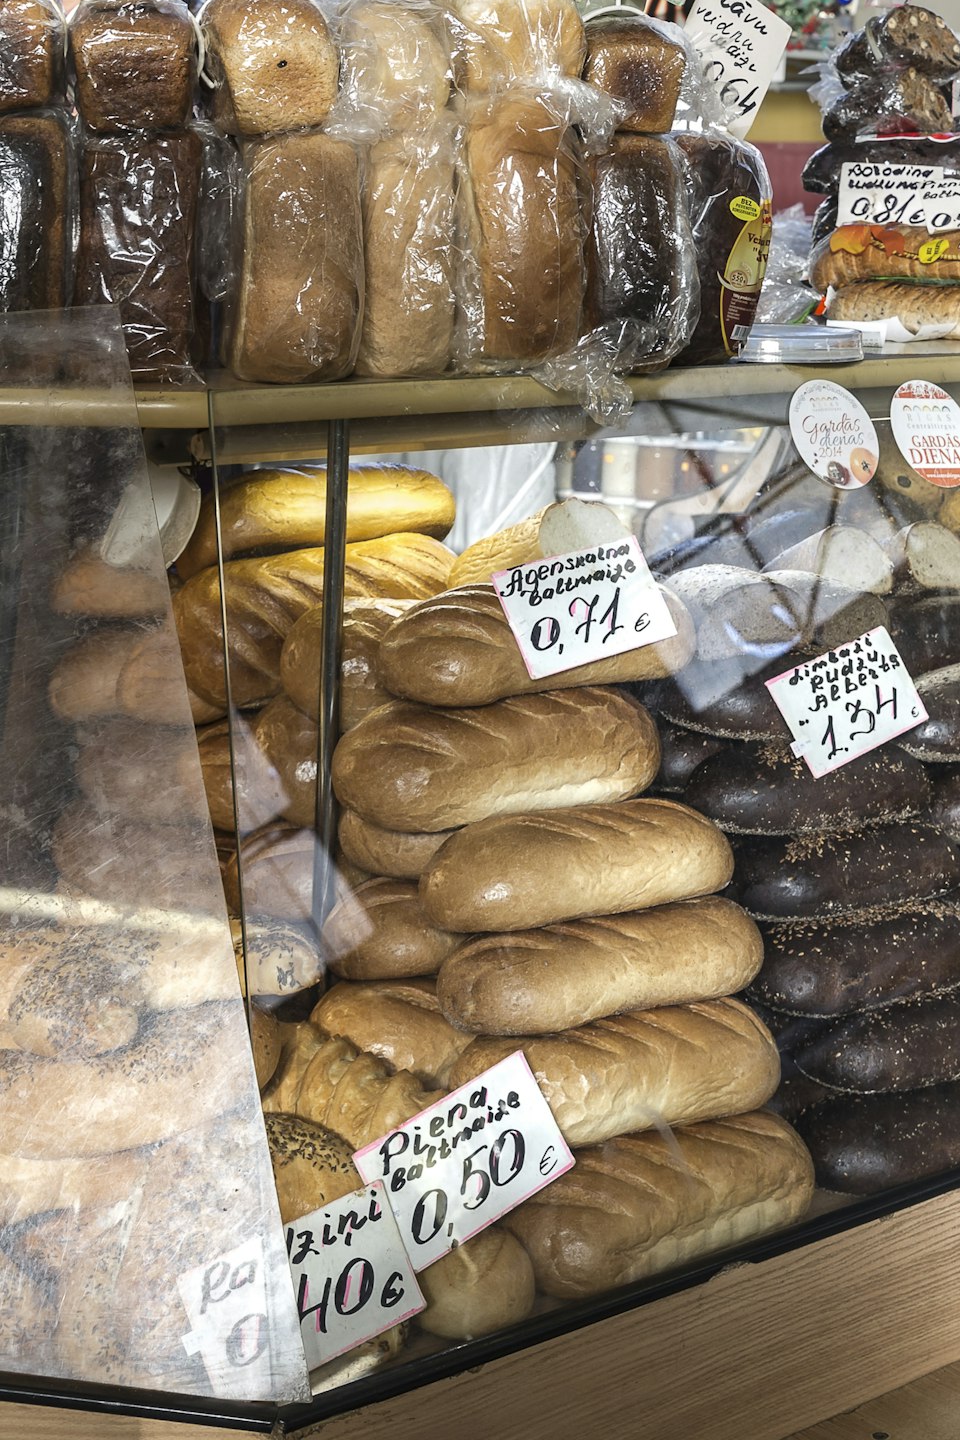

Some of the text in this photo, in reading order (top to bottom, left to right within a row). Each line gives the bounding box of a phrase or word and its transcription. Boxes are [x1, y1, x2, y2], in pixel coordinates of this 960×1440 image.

[802, 412, 861, 445] Gardās
[819, 427, 865, 448] dienas
[911, 433, 960, 448] GARDĀS
[818, 446, 843, 458] 2014
